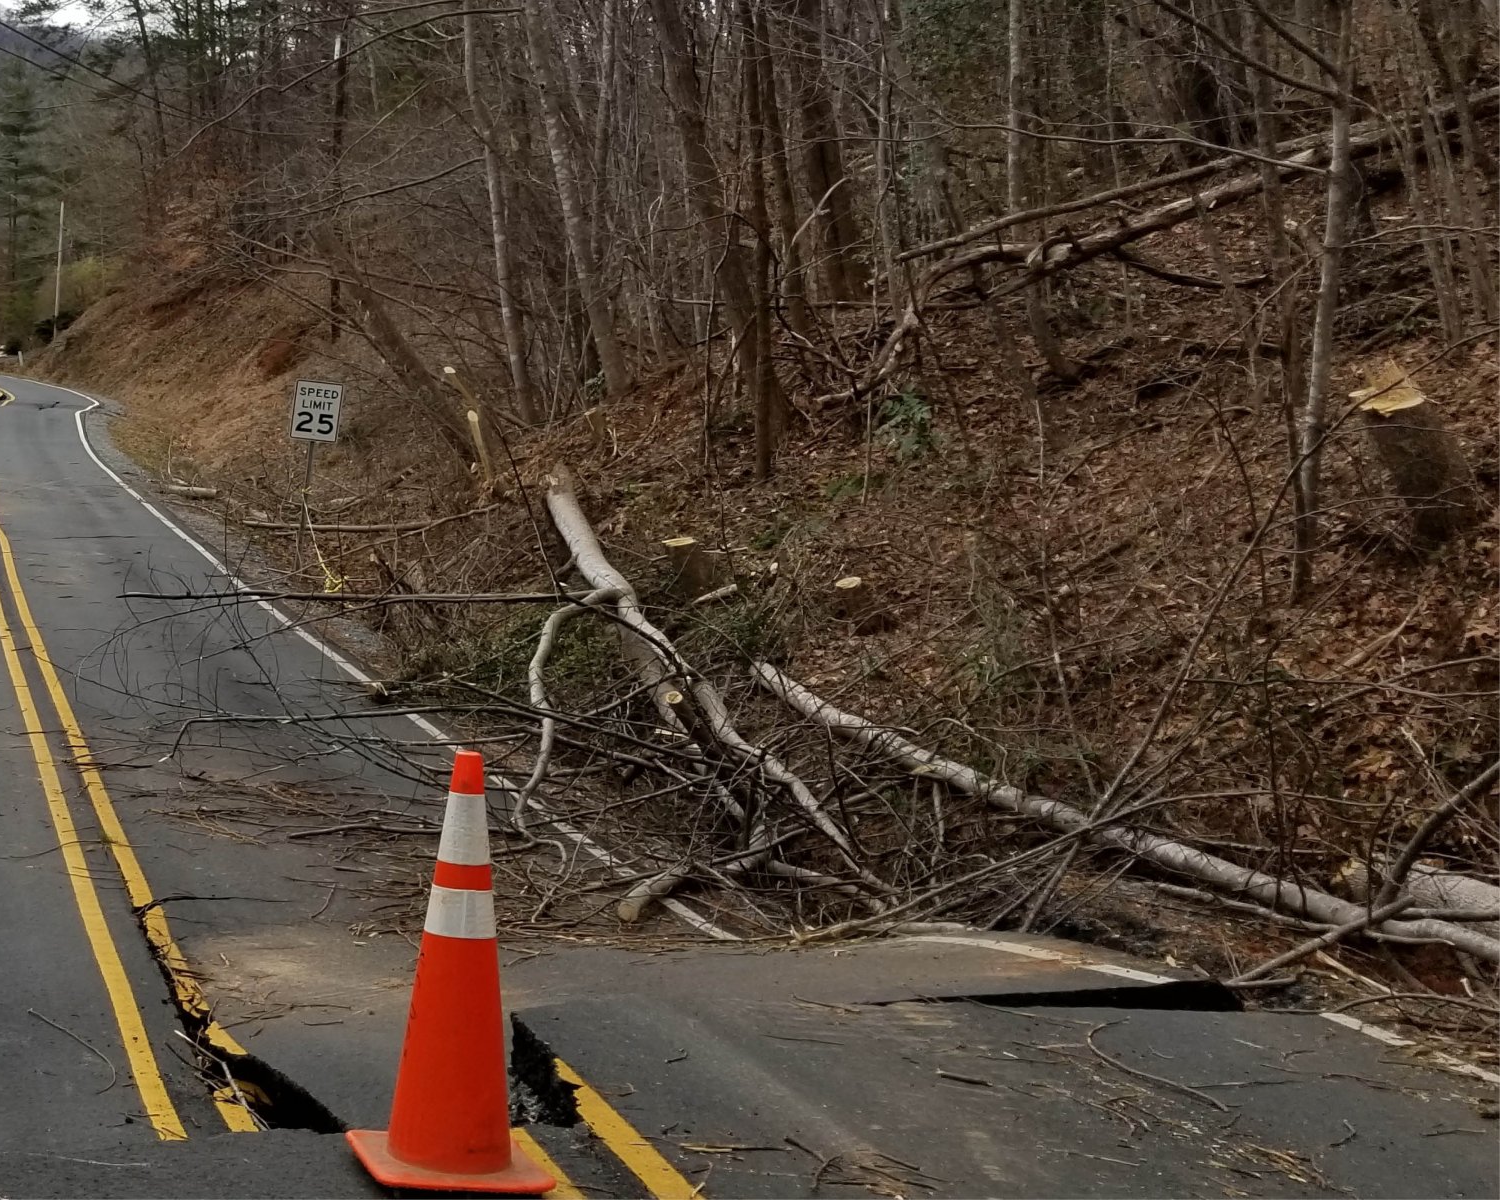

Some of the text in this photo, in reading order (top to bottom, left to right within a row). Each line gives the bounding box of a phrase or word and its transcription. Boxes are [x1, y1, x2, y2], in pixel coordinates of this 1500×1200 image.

[300, 387, 339, 399] SPEED
[302, 399, 333, 410] LIMIT
[295, 411, 334, 434] 25
